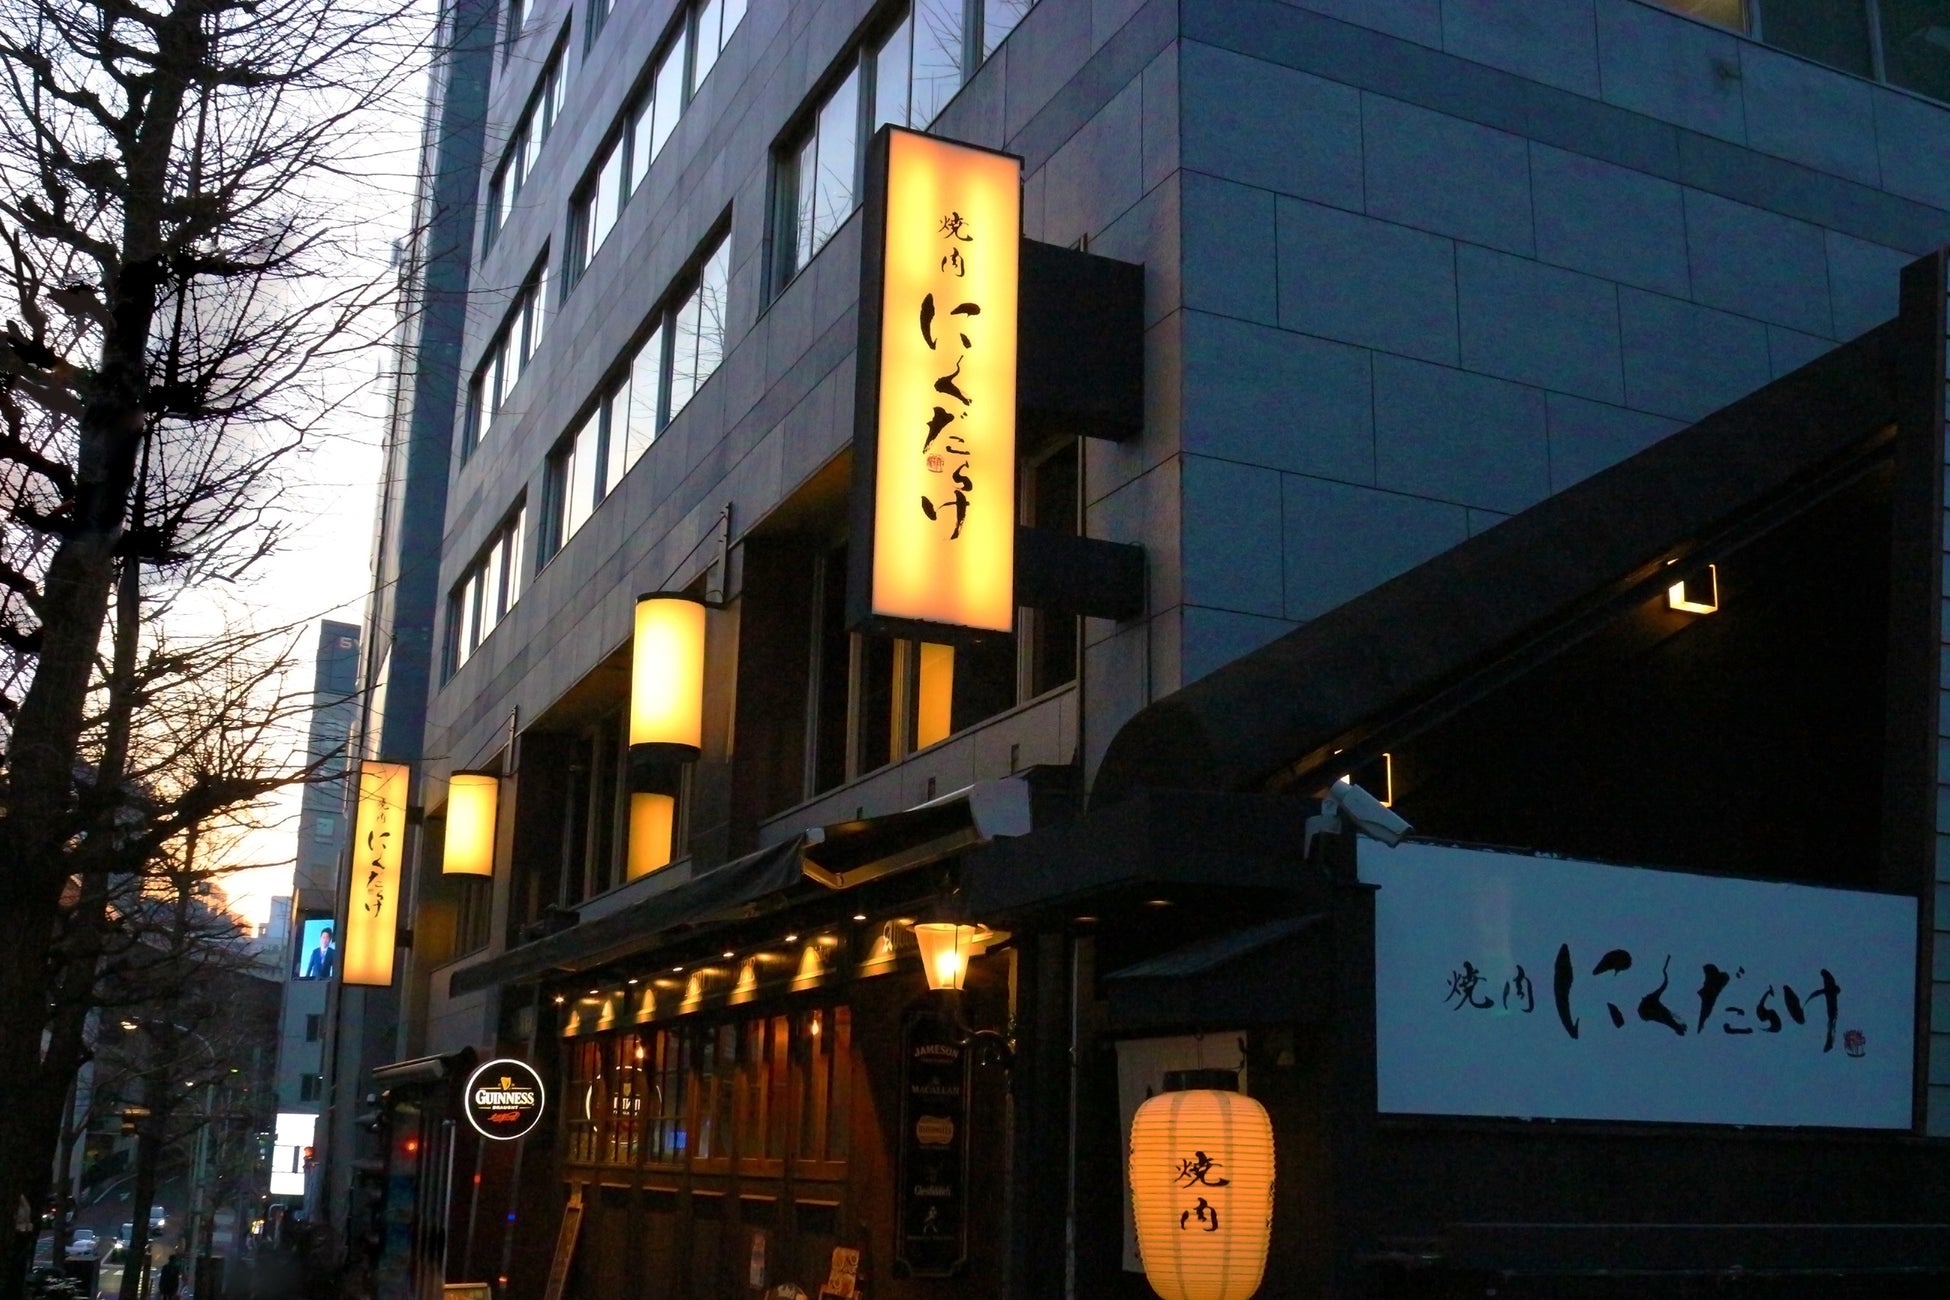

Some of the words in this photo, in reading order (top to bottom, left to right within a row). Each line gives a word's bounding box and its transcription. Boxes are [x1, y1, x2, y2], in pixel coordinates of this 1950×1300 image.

[938, 211, 974, 278] 焼肉
[919, 292, 981, 541] にくだらけ
[1444, 960, 1535, 1013] 焼肉
[1553, 943, 1842, 1053] にくだらけ
[914, 1044, 959, 1058] JAMESON
[475, 1089, 535, 1105] GUINNESS
[1174, 1151, 1231, 1232] 焼肉
